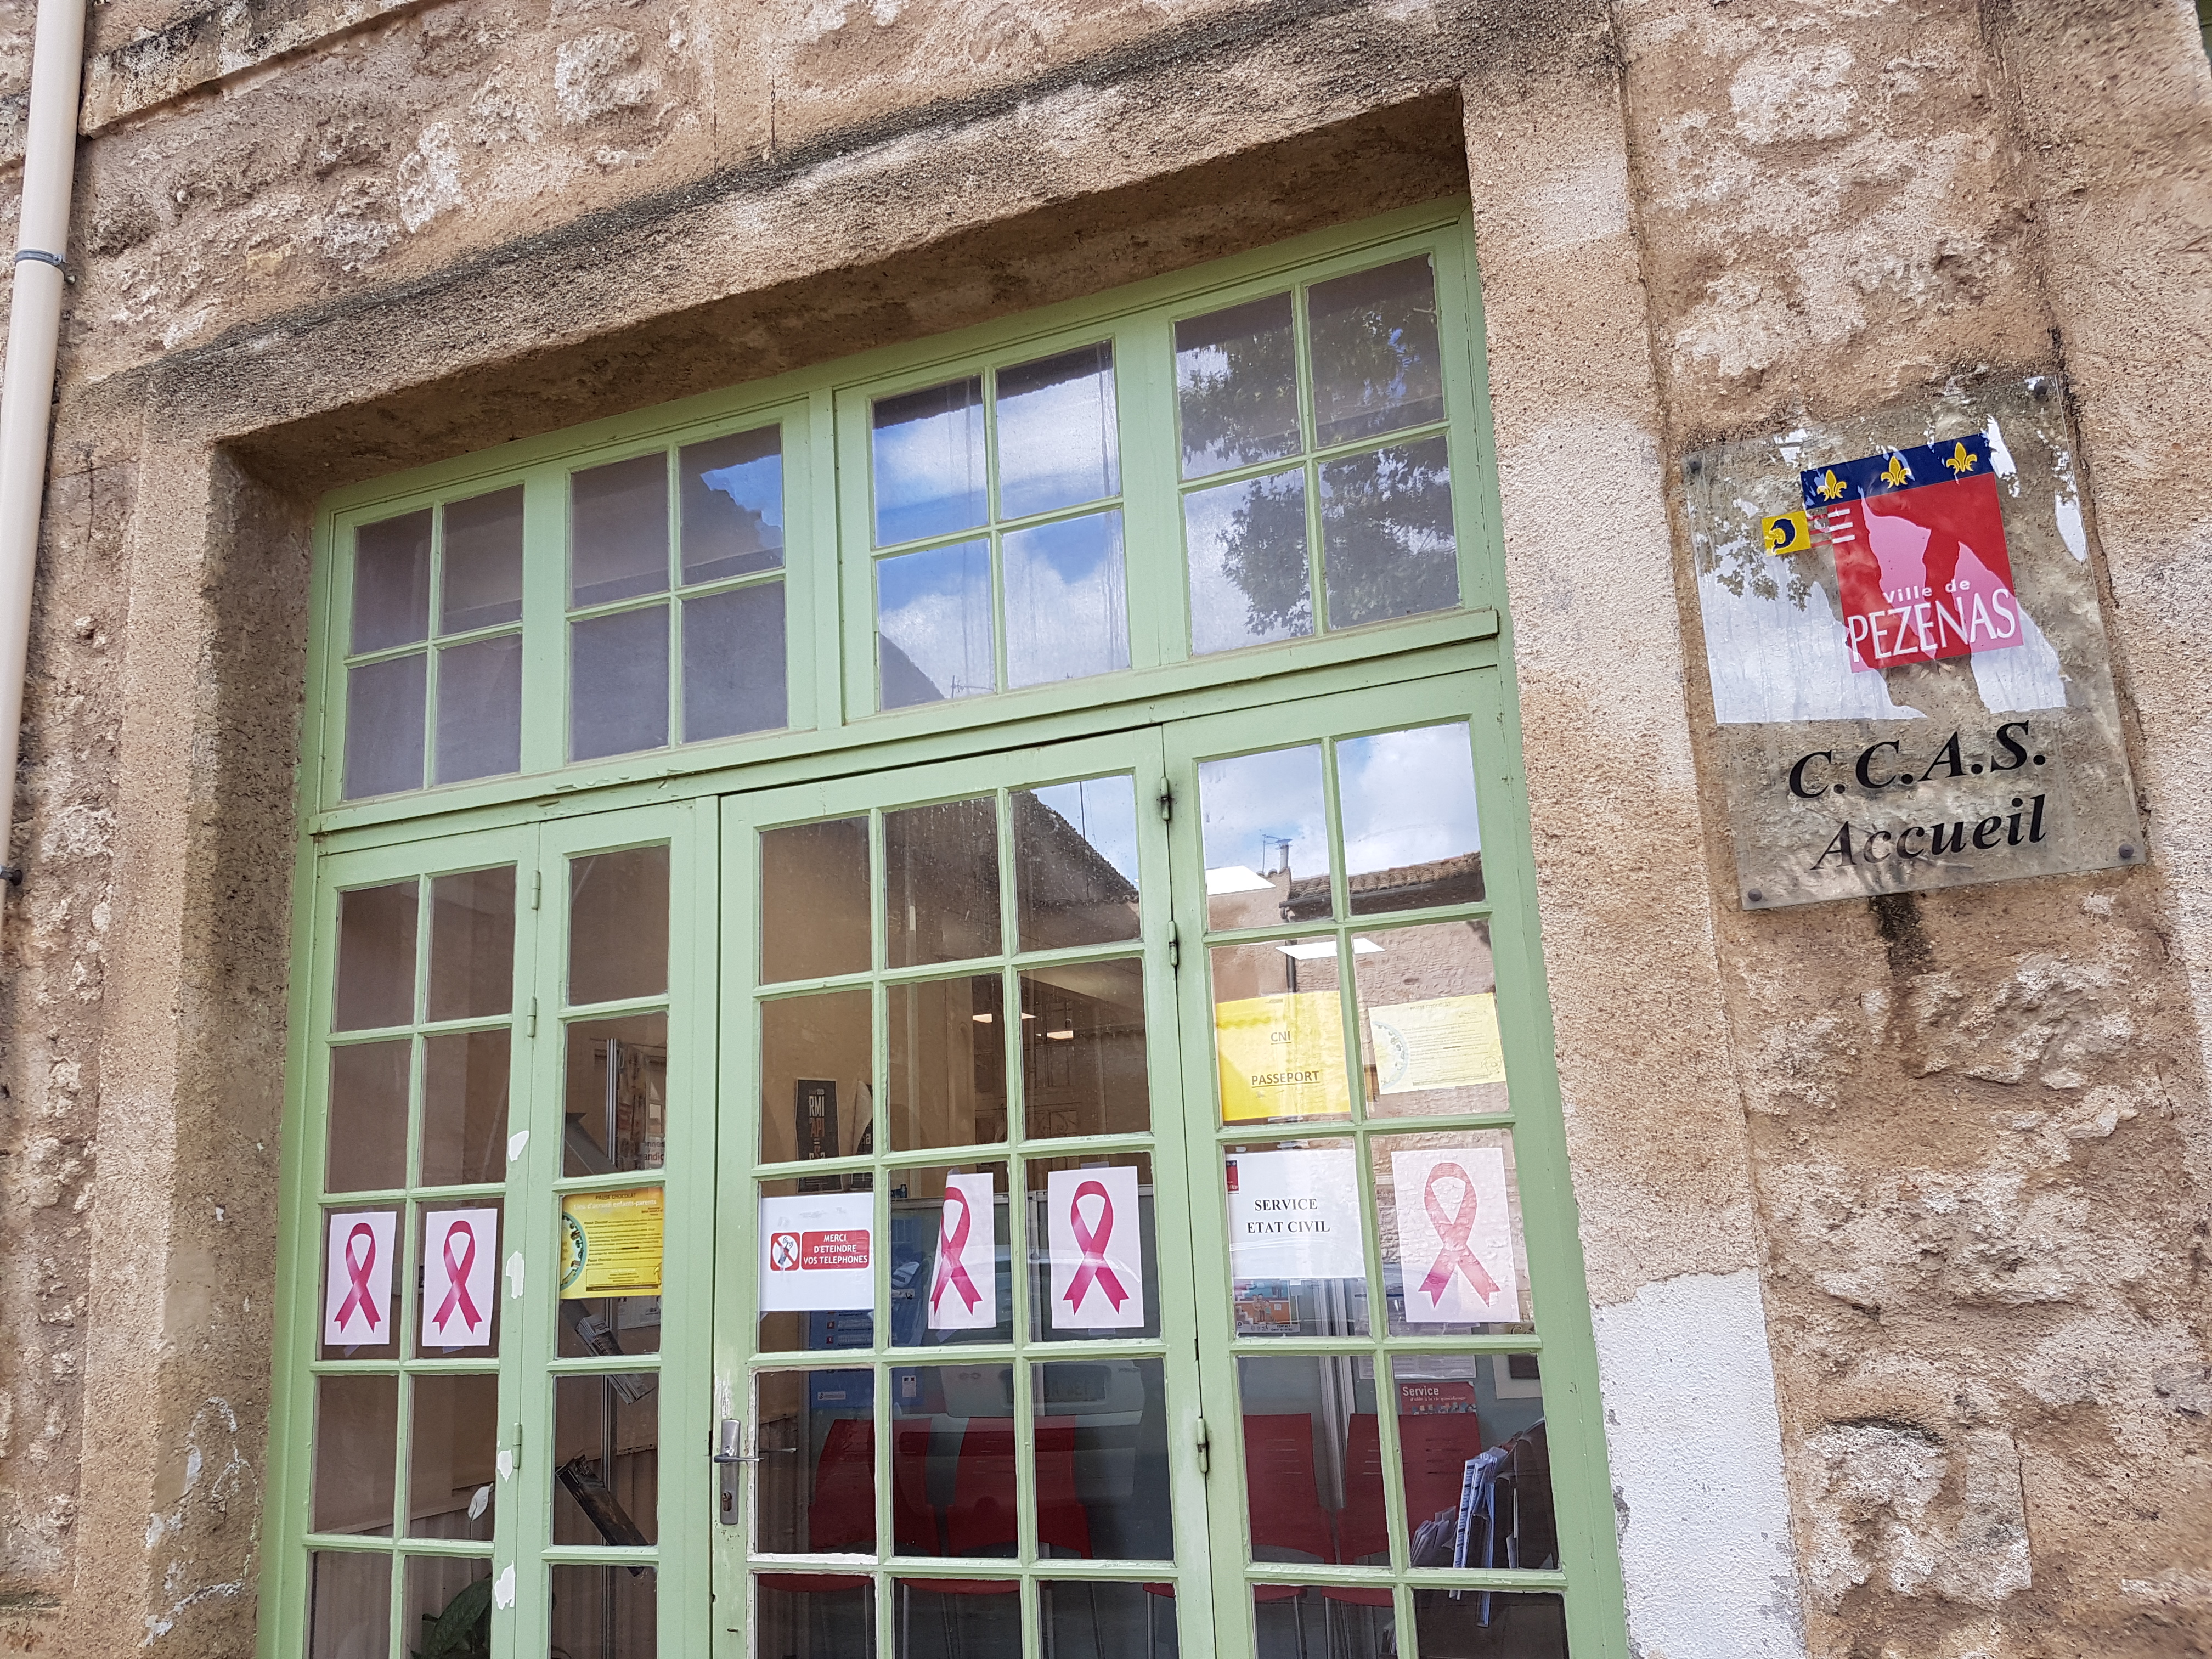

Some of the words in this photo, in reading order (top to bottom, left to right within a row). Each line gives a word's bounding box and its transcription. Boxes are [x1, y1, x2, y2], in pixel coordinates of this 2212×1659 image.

[1945, 578, 1971, 593] de
[1789, 720, 2046, 799] C.C.A.S.
[1810, 794, 2046, 870] Accueil
[1271, 1031, 1291, 1042] CNI
[1251, 1070, 1320, 1086] PASSEPORT
[809, 1096, 825, 1117] RMI
[1255, 1198, 1318, 1211] SERVICE
[1247, 1221, 1284, 1233] ETAT
[1288, 1221, 1330, 1233] CIVIL
[823, 1234, 847, 1243] MERCI
[814, 1244, 857, 1254] D'ETEINDRE
[804, 1256, 817, 1265] VOS
[820, 1255, 868, 1264] TELEPHONES
[1402, 1385, 1439, 1396] Service
